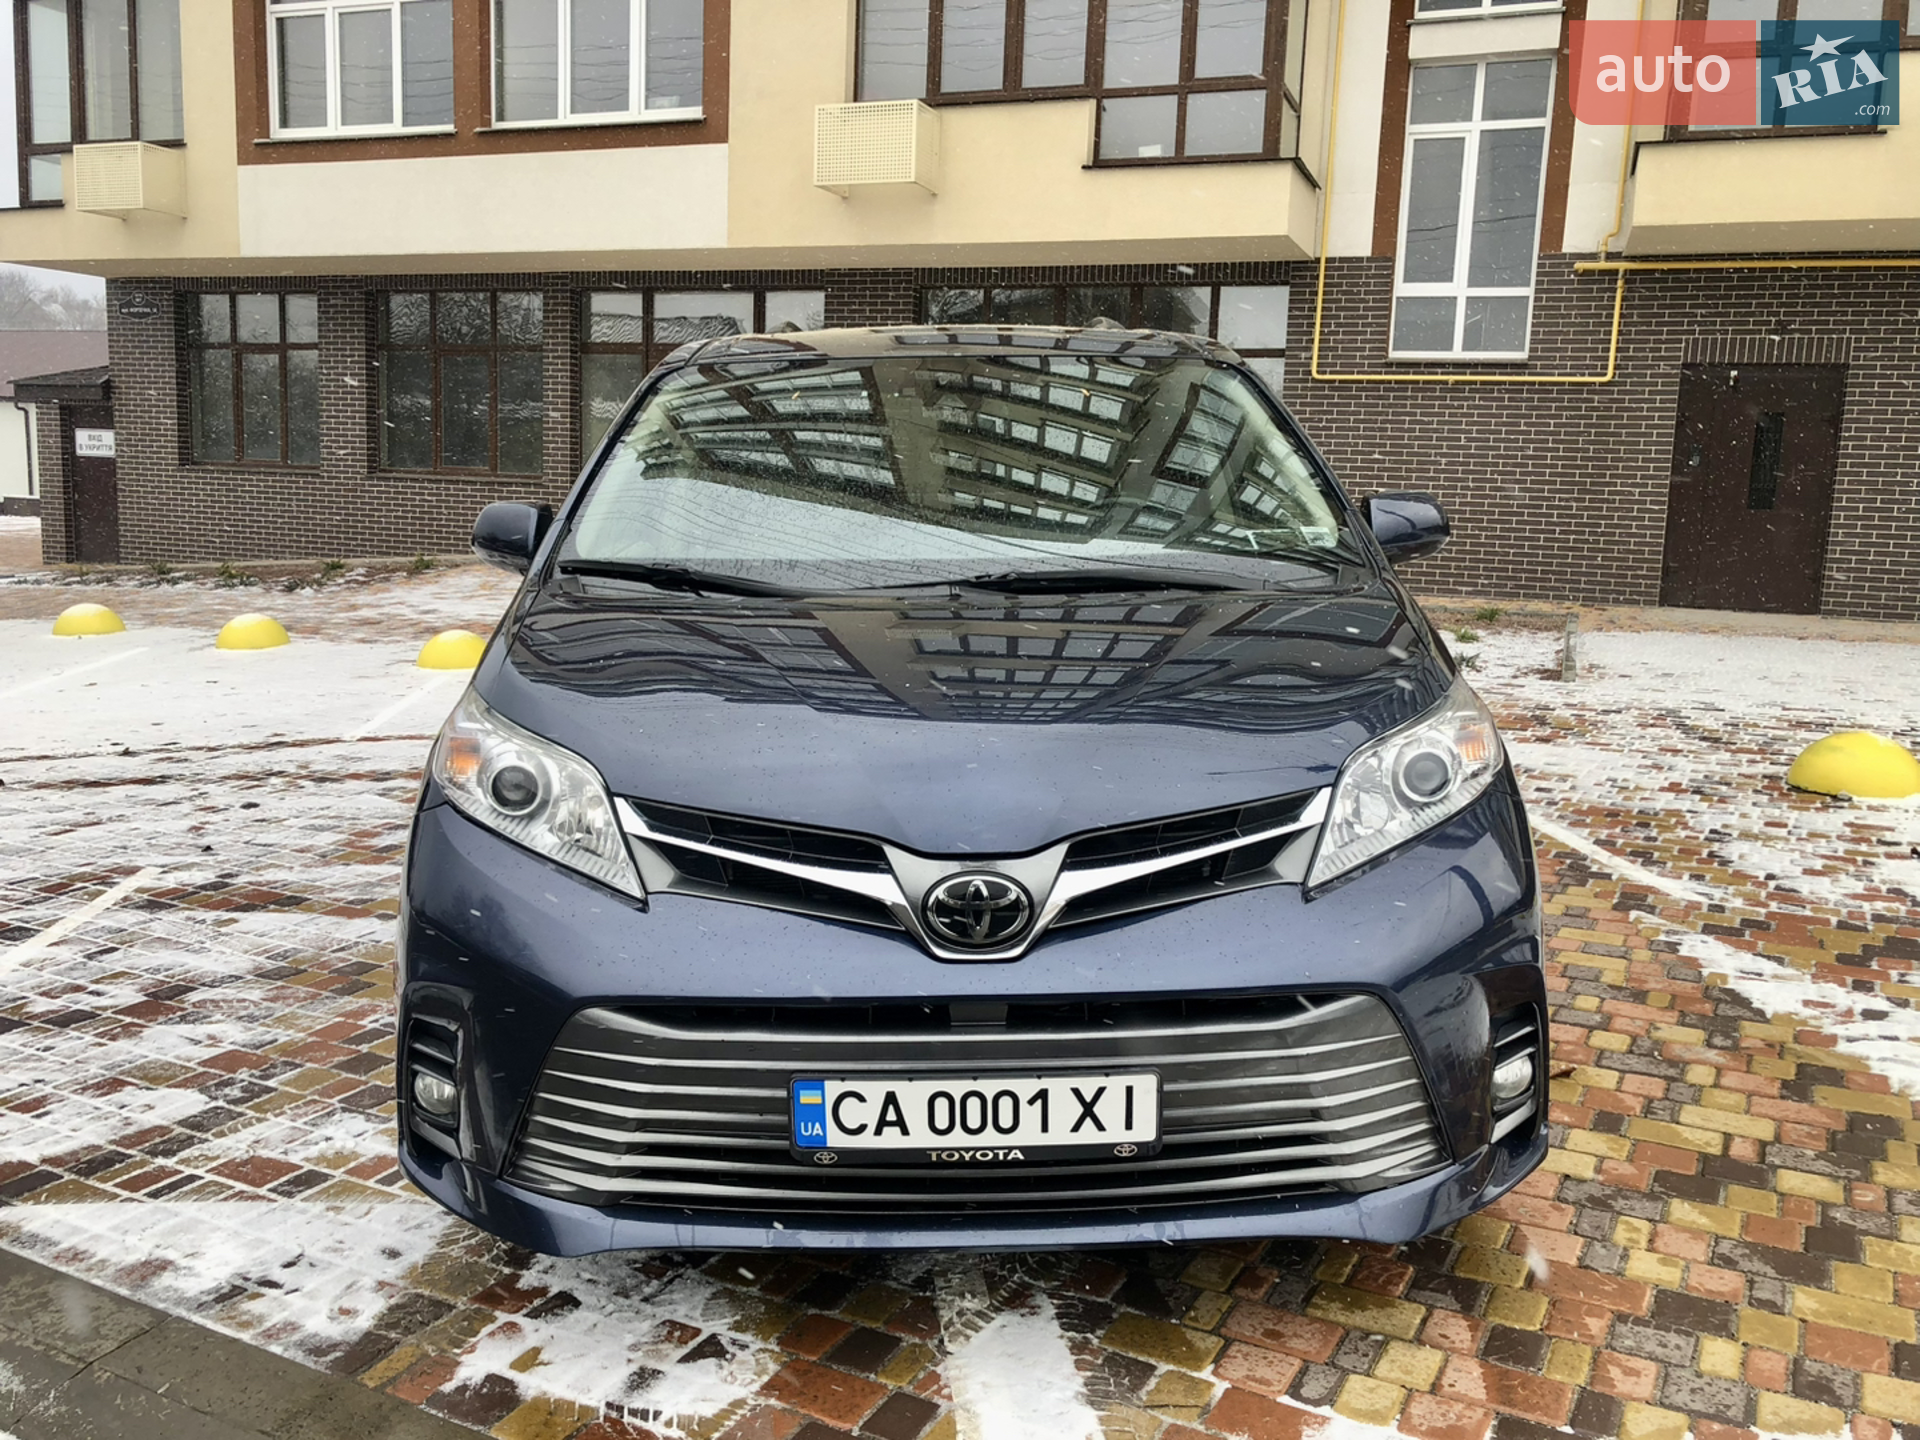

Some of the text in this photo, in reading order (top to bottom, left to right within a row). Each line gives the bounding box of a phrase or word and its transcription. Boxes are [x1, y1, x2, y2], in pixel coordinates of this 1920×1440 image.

[831, 1090, 910, 1137] CA
[927, 1087, 1049, 1136] 0001
[800, 1122, 824, 1137] UA
[926, 1149, 1025, 1162] TOYOTA
